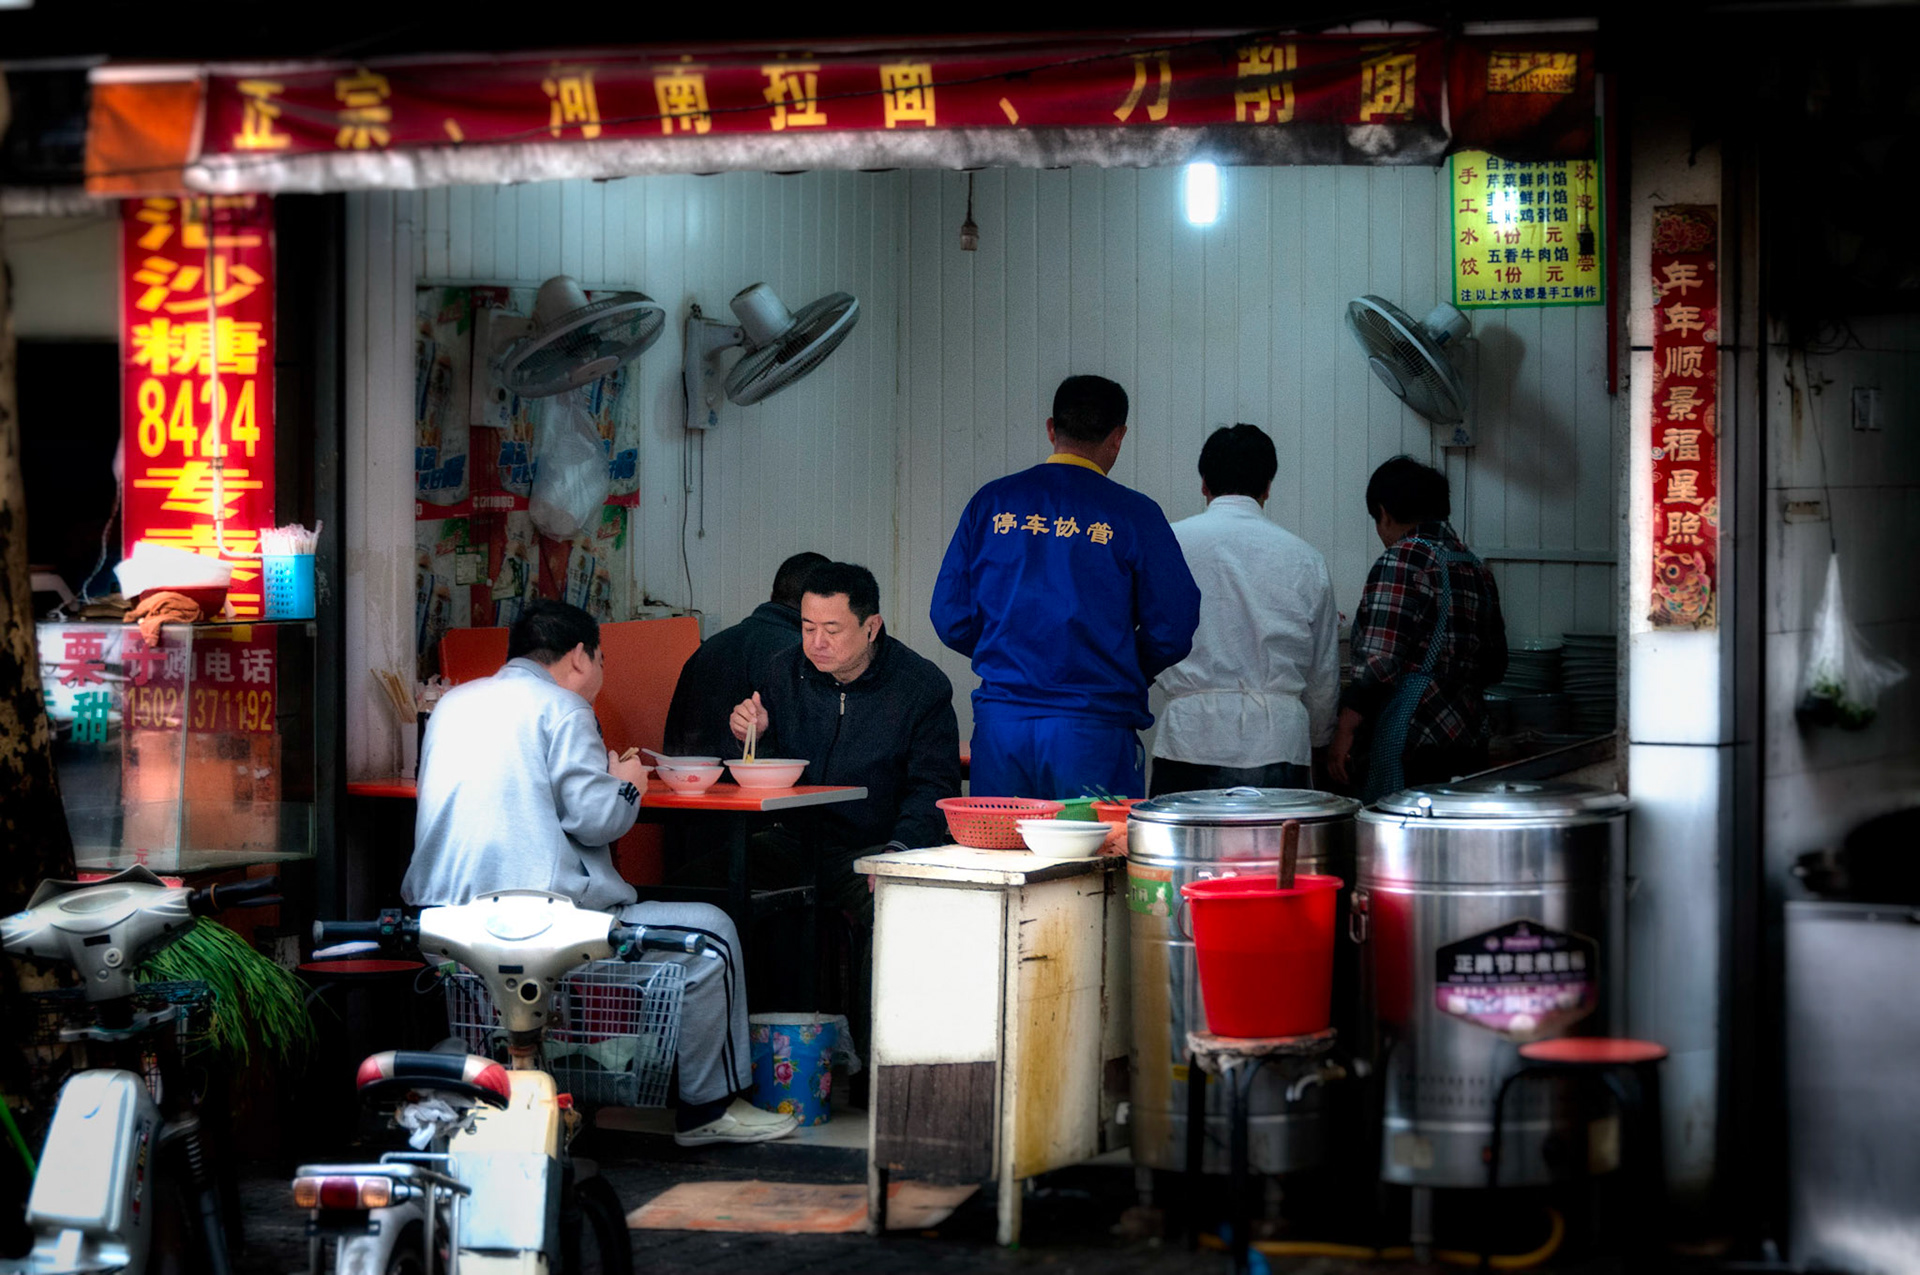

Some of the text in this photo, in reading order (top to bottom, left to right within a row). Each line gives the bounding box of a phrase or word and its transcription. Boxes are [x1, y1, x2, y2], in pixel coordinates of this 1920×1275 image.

[1486, 172, 1568, 188] 芹菜鲜肉馅
[1458, 166, 1479, 276] 手工水饺
[1574, 161, 1596, 273] 欢迎尝
[1546, 227, 1563, 244] 元
[1487, 246, 1569, 264] 五香牛肉馅
[1494, 266, 1564, 284] 1份 元
[137, 379, 260, 458] 8424
[1661, 260, 1705, 547] 年年顺景福星照
[992, 511, 1114, 546] 停车协管
